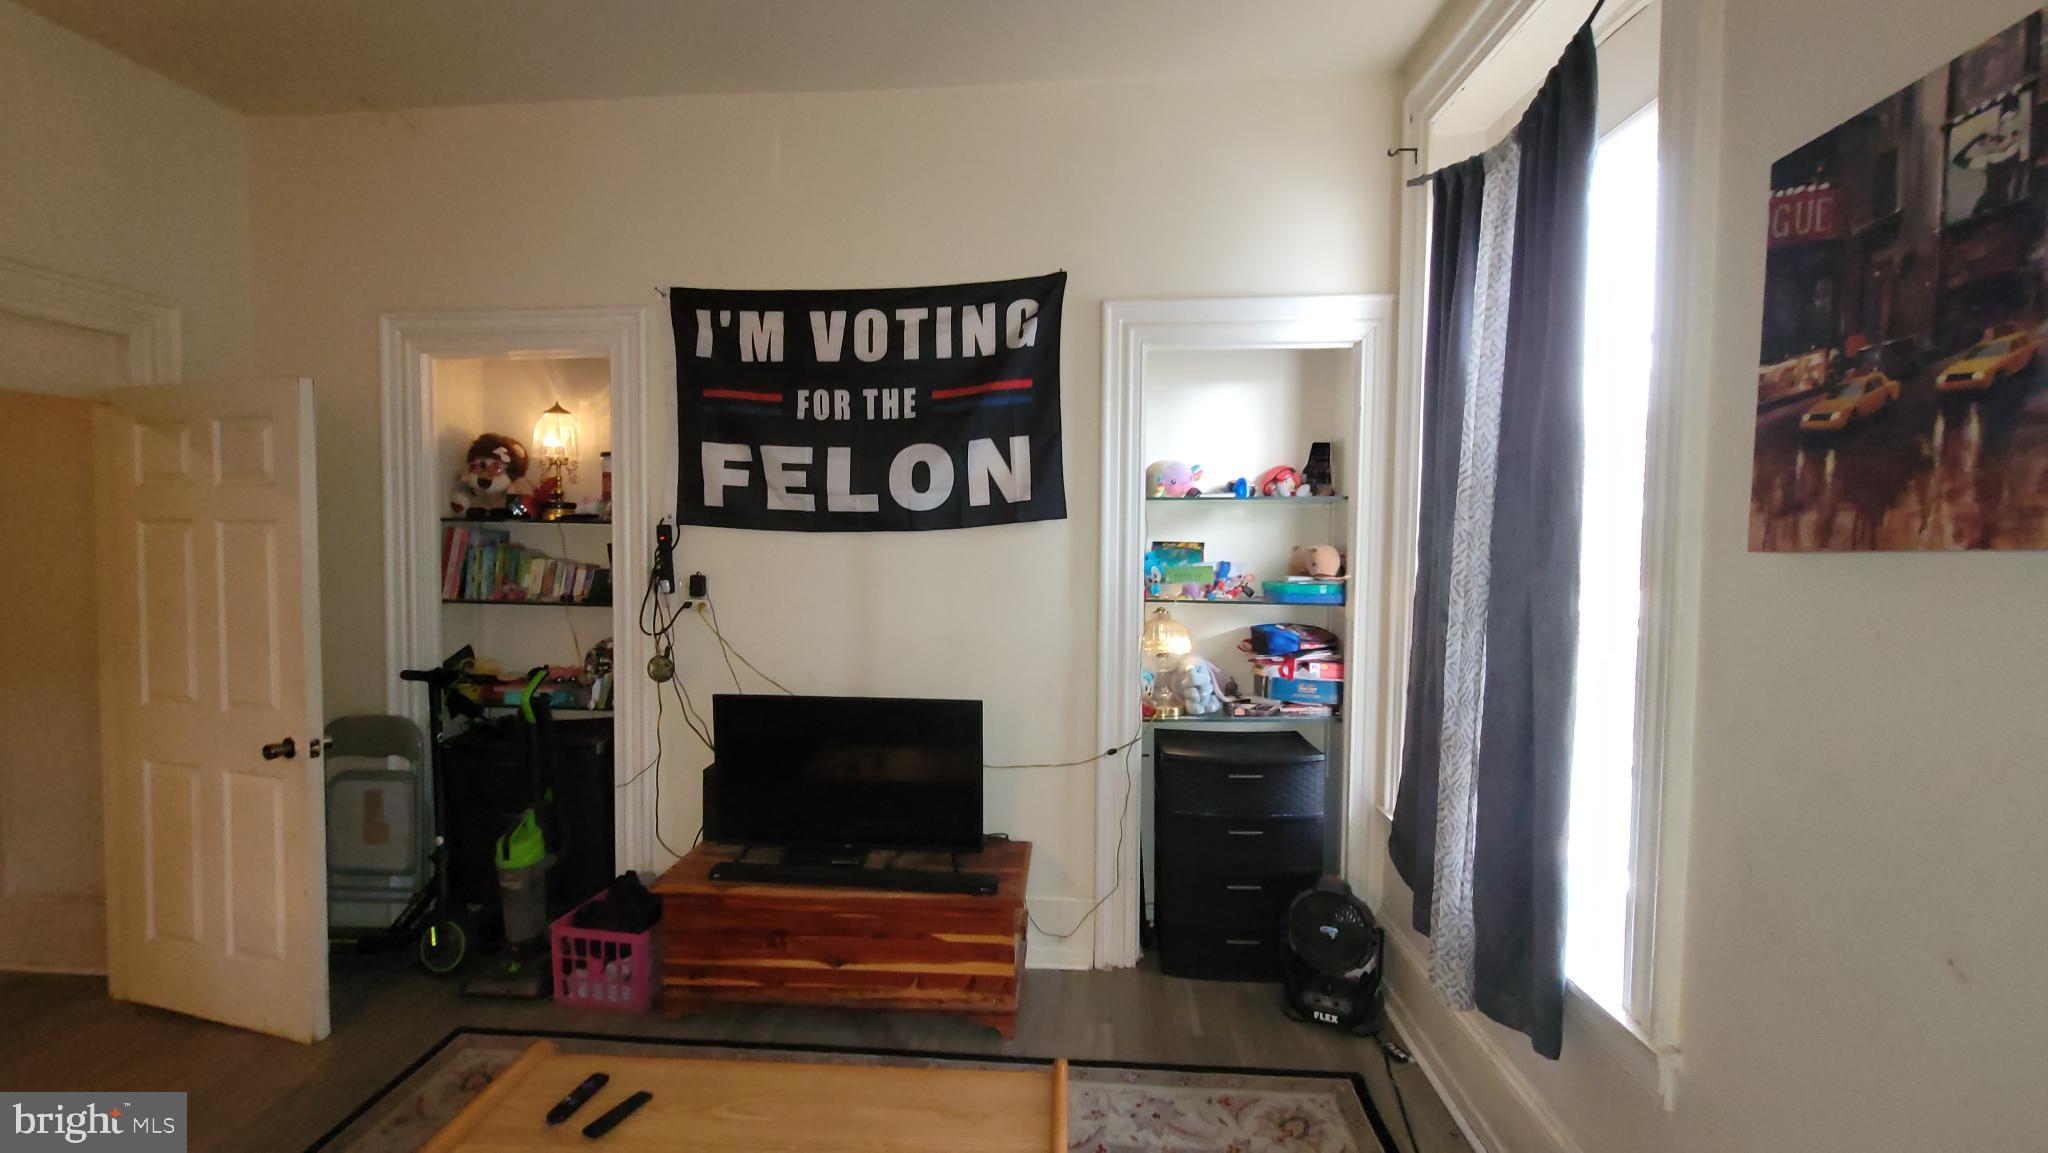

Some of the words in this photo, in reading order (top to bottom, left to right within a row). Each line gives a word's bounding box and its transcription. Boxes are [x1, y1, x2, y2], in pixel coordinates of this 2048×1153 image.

[695, 308, 785, 362] I'M
[809, 298, 1039, 362] VOTING
[796, 389, 851, 421] FOR
[863, 387, 917, 420] THE
[701, 435, 1032, 513] FELON
[1313, 1011, 1339, 1024] FLEX
